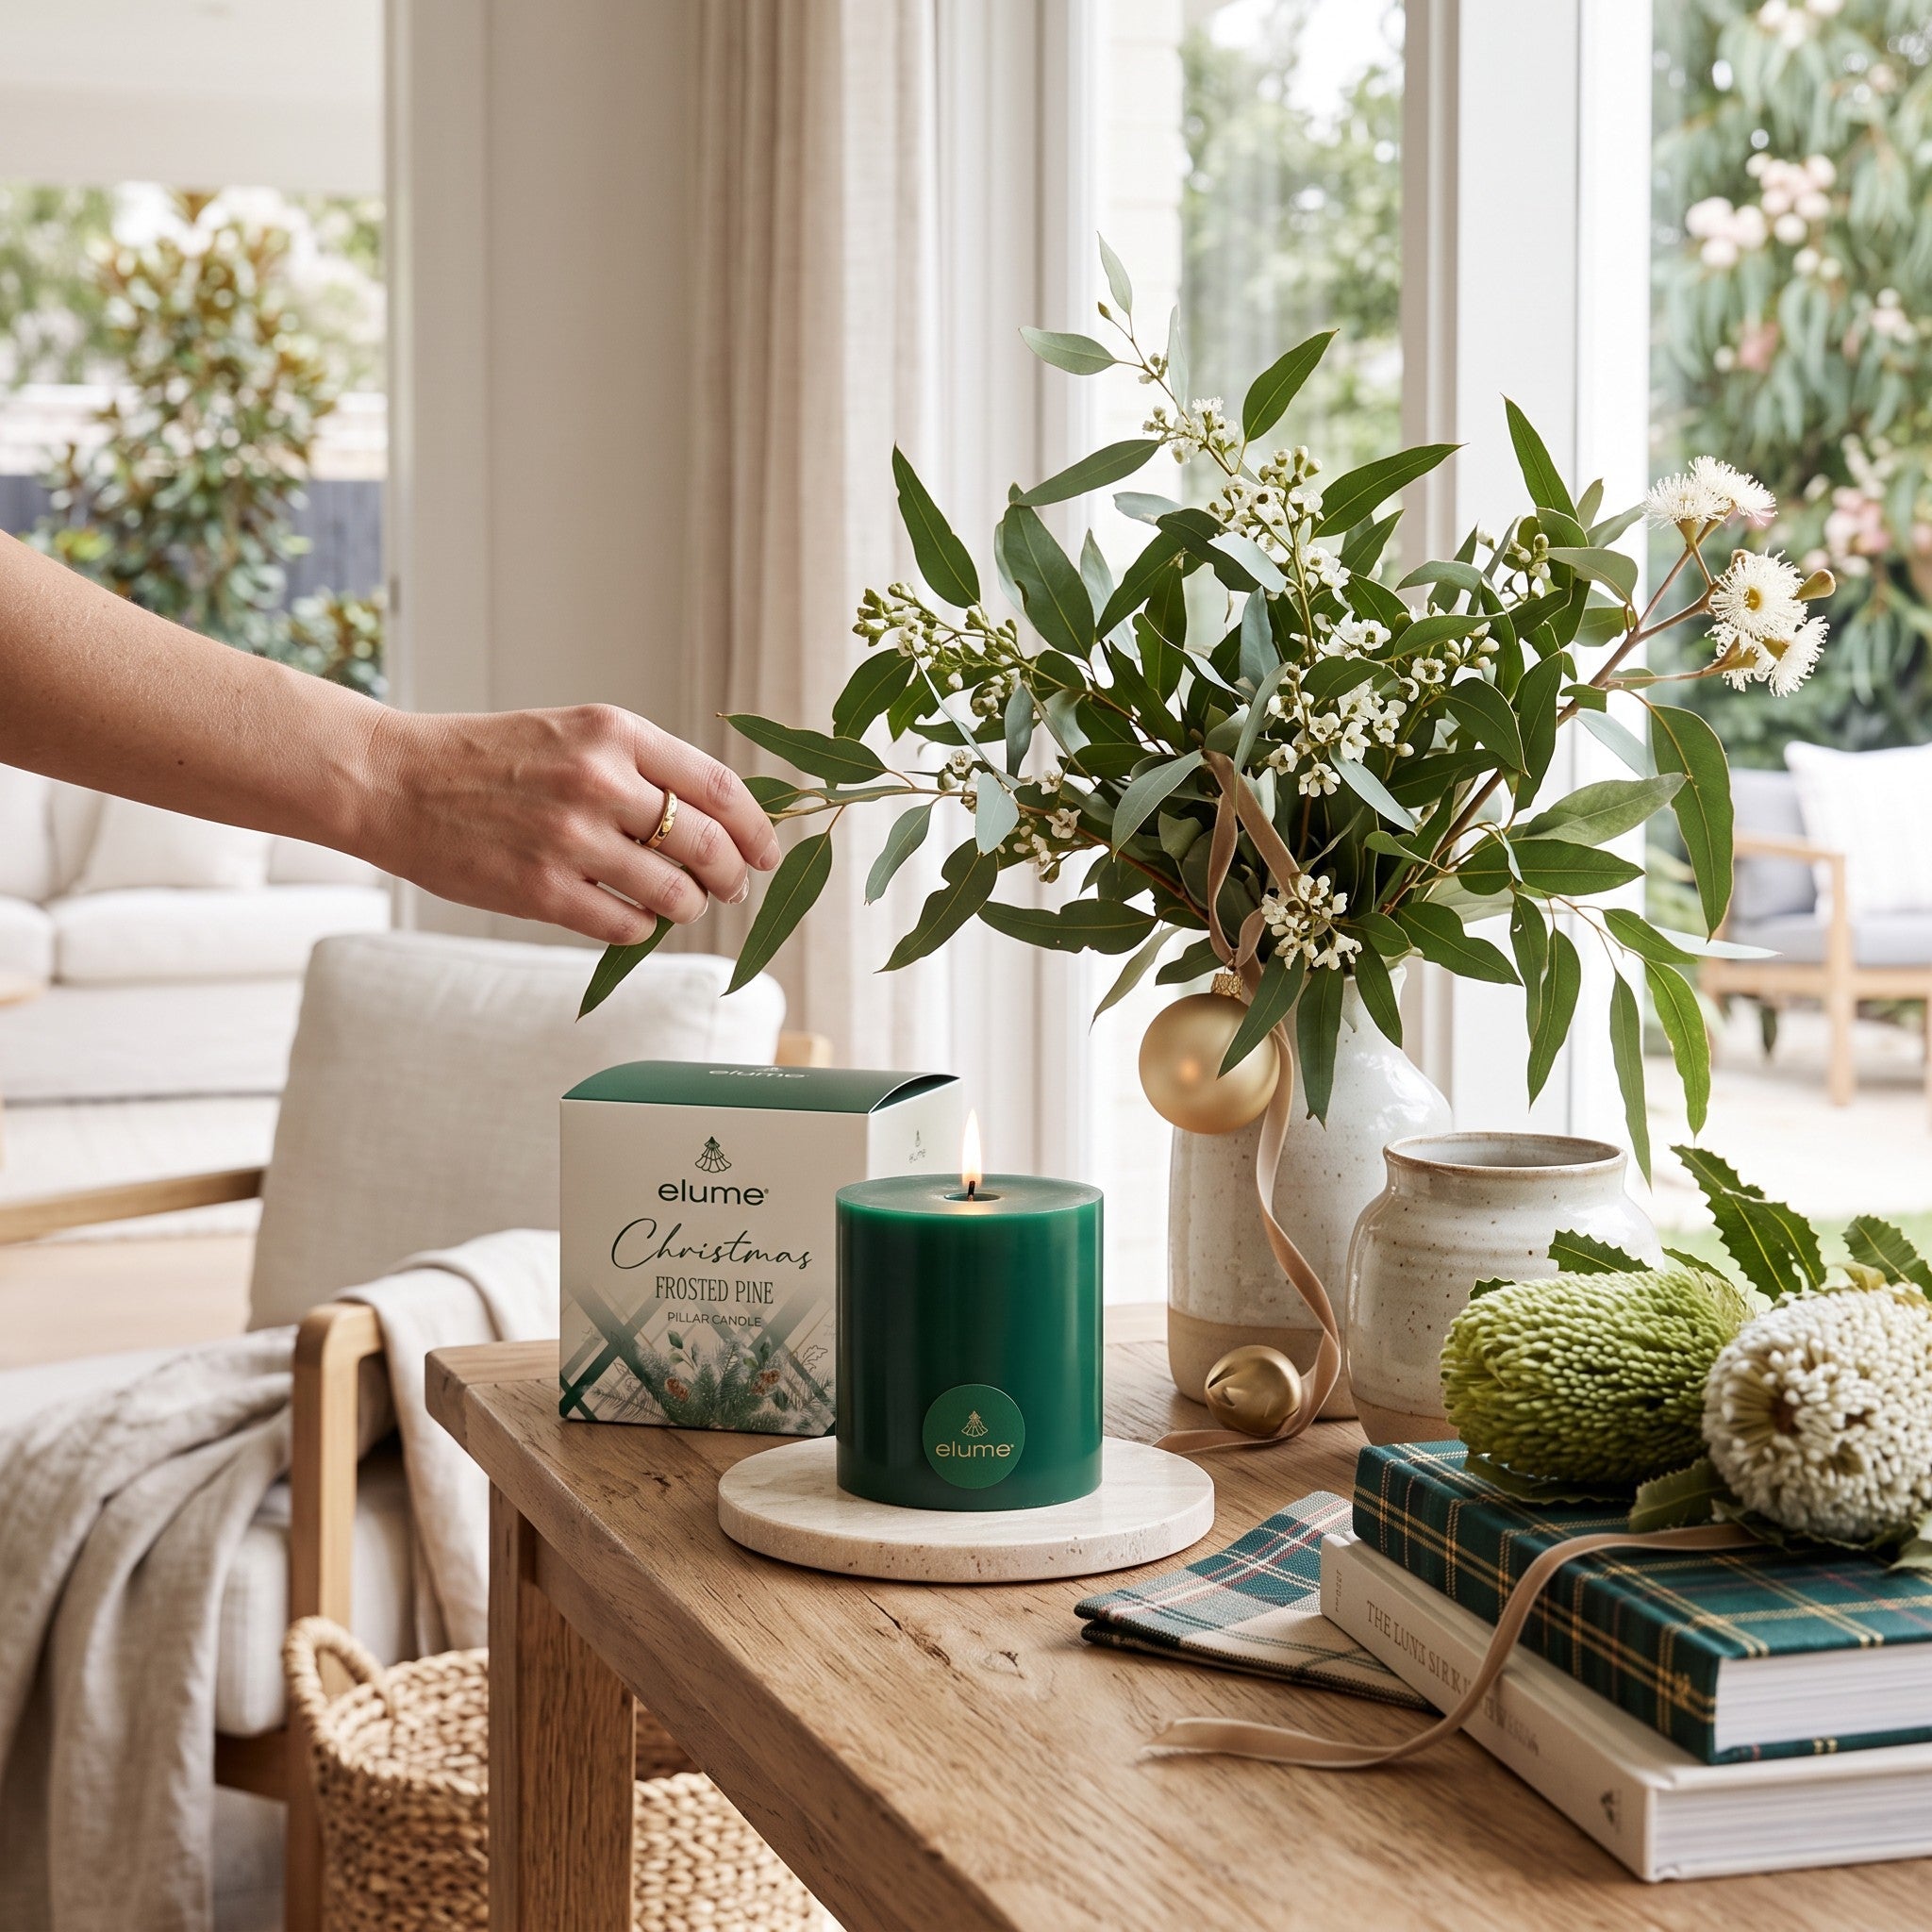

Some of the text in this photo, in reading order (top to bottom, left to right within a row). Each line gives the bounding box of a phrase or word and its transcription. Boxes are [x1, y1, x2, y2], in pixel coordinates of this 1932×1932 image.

[611, 1218, 812, 1270] Christmas
[655, 1275, 774, 1305] FROSTED PINE
[667, 1311, 762, 1327] PILLAR CANDLE
[1367, 1600, 1391, 1639] THE
